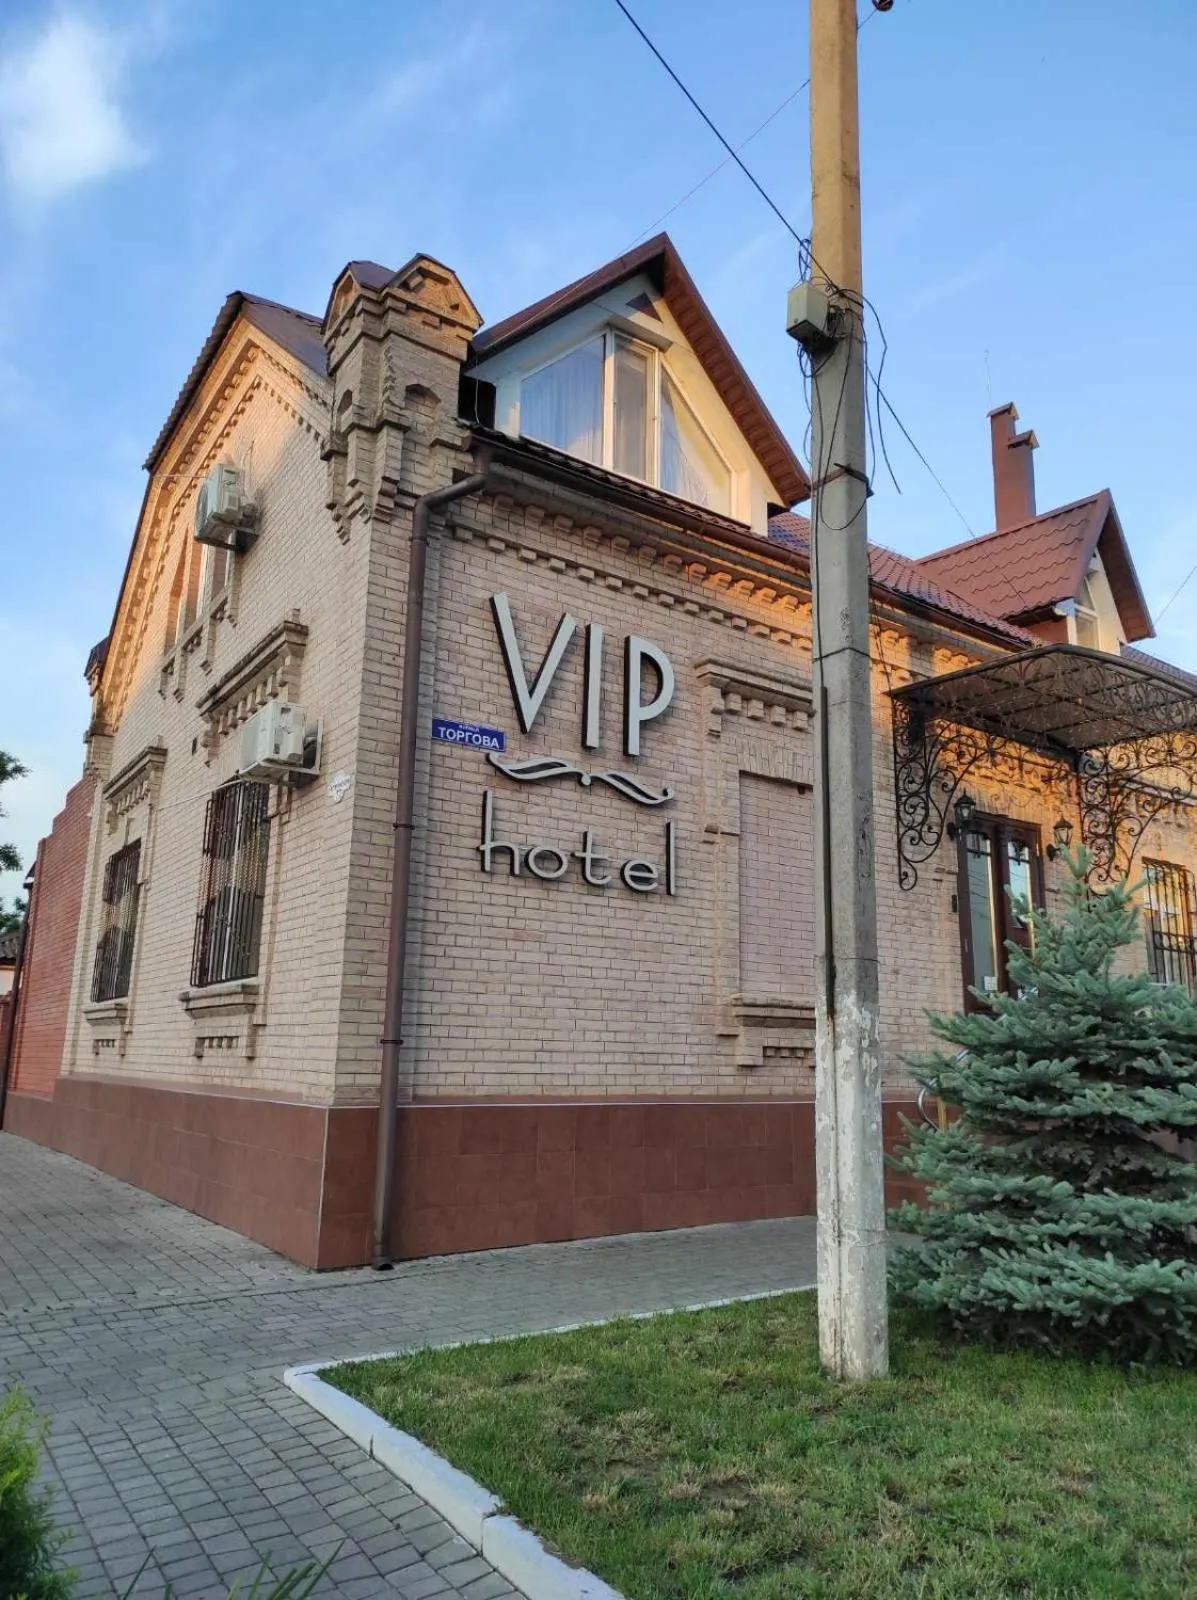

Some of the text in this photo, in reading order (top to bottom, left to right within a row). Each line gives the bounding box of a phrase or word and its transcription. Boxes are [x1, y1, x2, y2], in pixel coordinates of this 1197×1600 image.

[489, 590, 676, 757] VIP
[438, 727, 500, 749] ТОРГОВА
[476, 789, 676, 897] hotel
